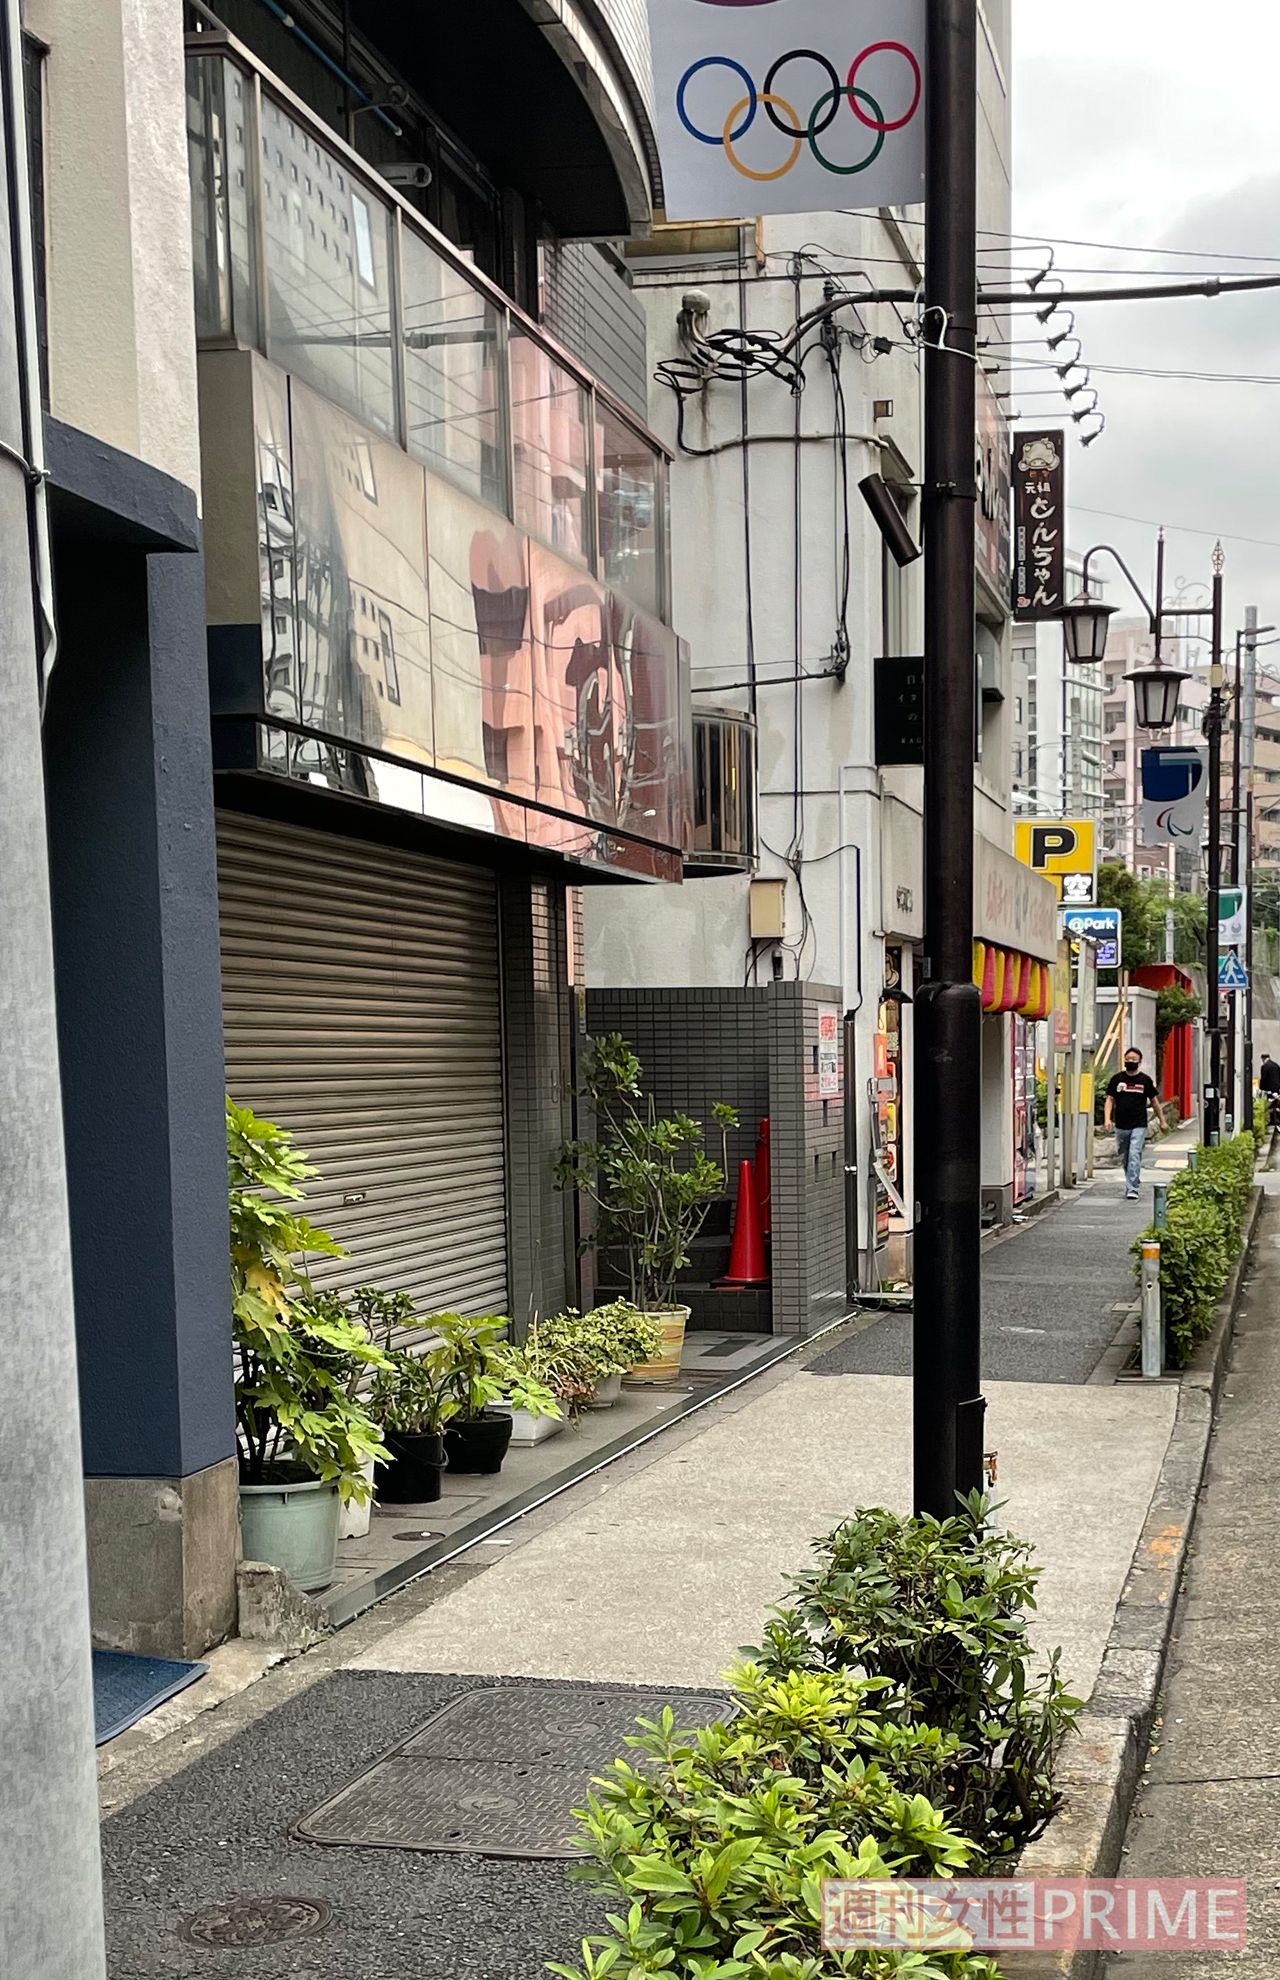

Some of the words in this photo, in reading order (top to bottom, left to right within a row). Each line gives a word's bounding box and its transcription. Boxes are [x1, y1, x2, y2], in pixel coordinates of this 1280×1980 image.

[1030, 496, 1058, 607] とんちゃん
[1030, 825, 1077, 870] P
[1068, 917, 1116, 935] @Park
